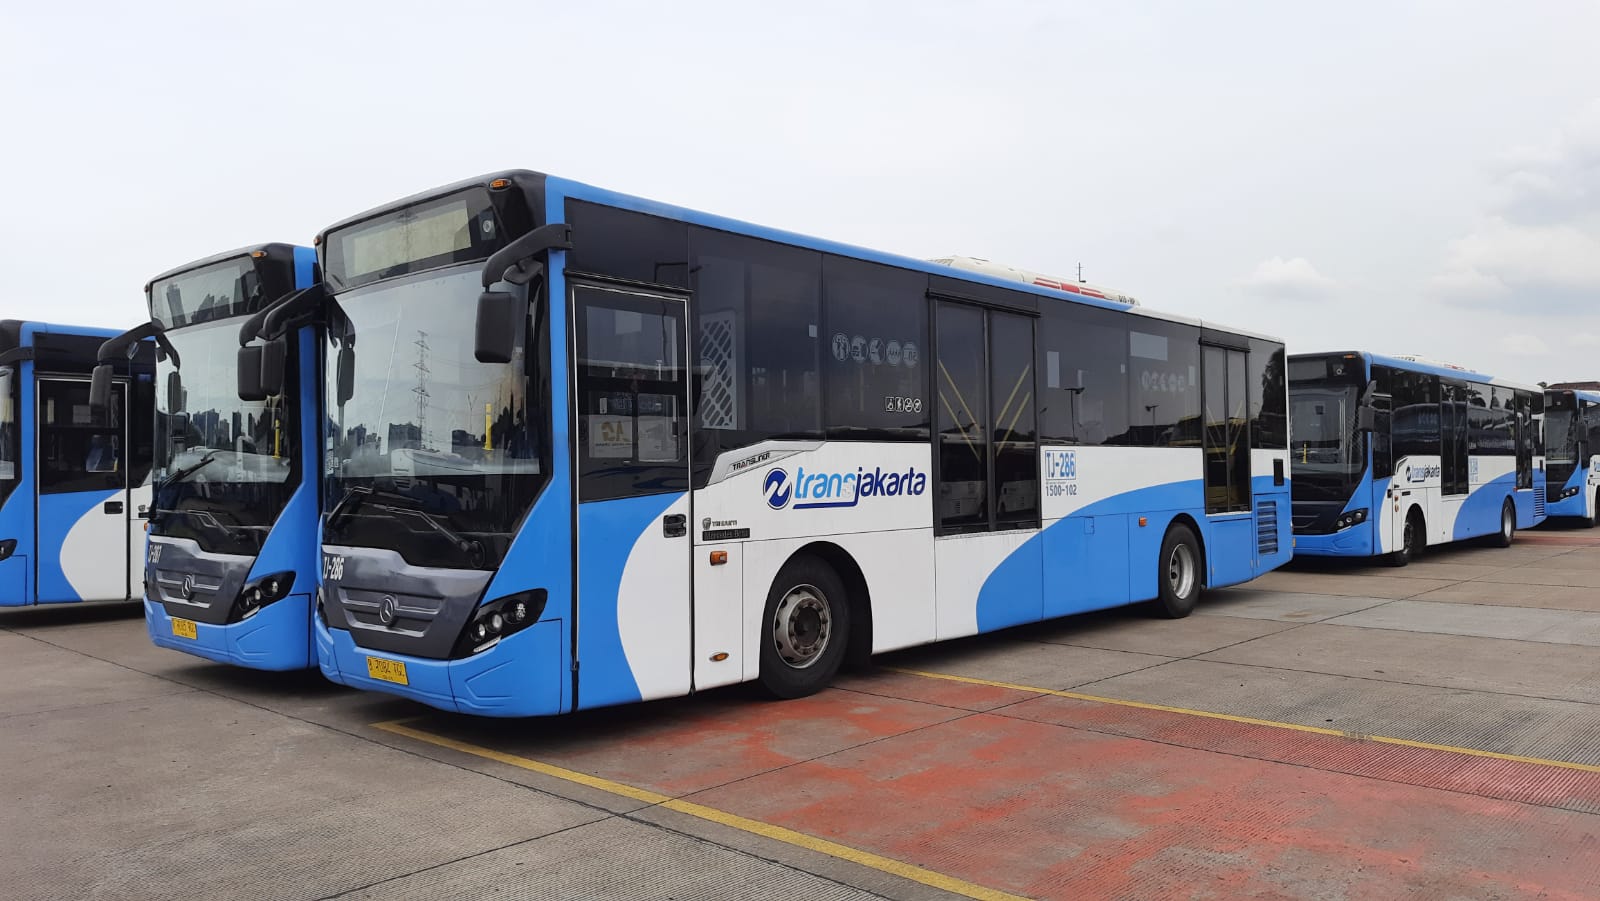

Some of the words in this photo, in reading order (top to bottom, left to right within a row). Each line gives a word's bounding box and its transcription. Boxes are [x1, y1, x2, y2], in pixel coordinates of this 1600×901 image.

[1046, 452, 1075, 478] TJ-286
[794, 466, 927, 508] transjakarta
[1046, 484, 1077, 496] 1500-102
